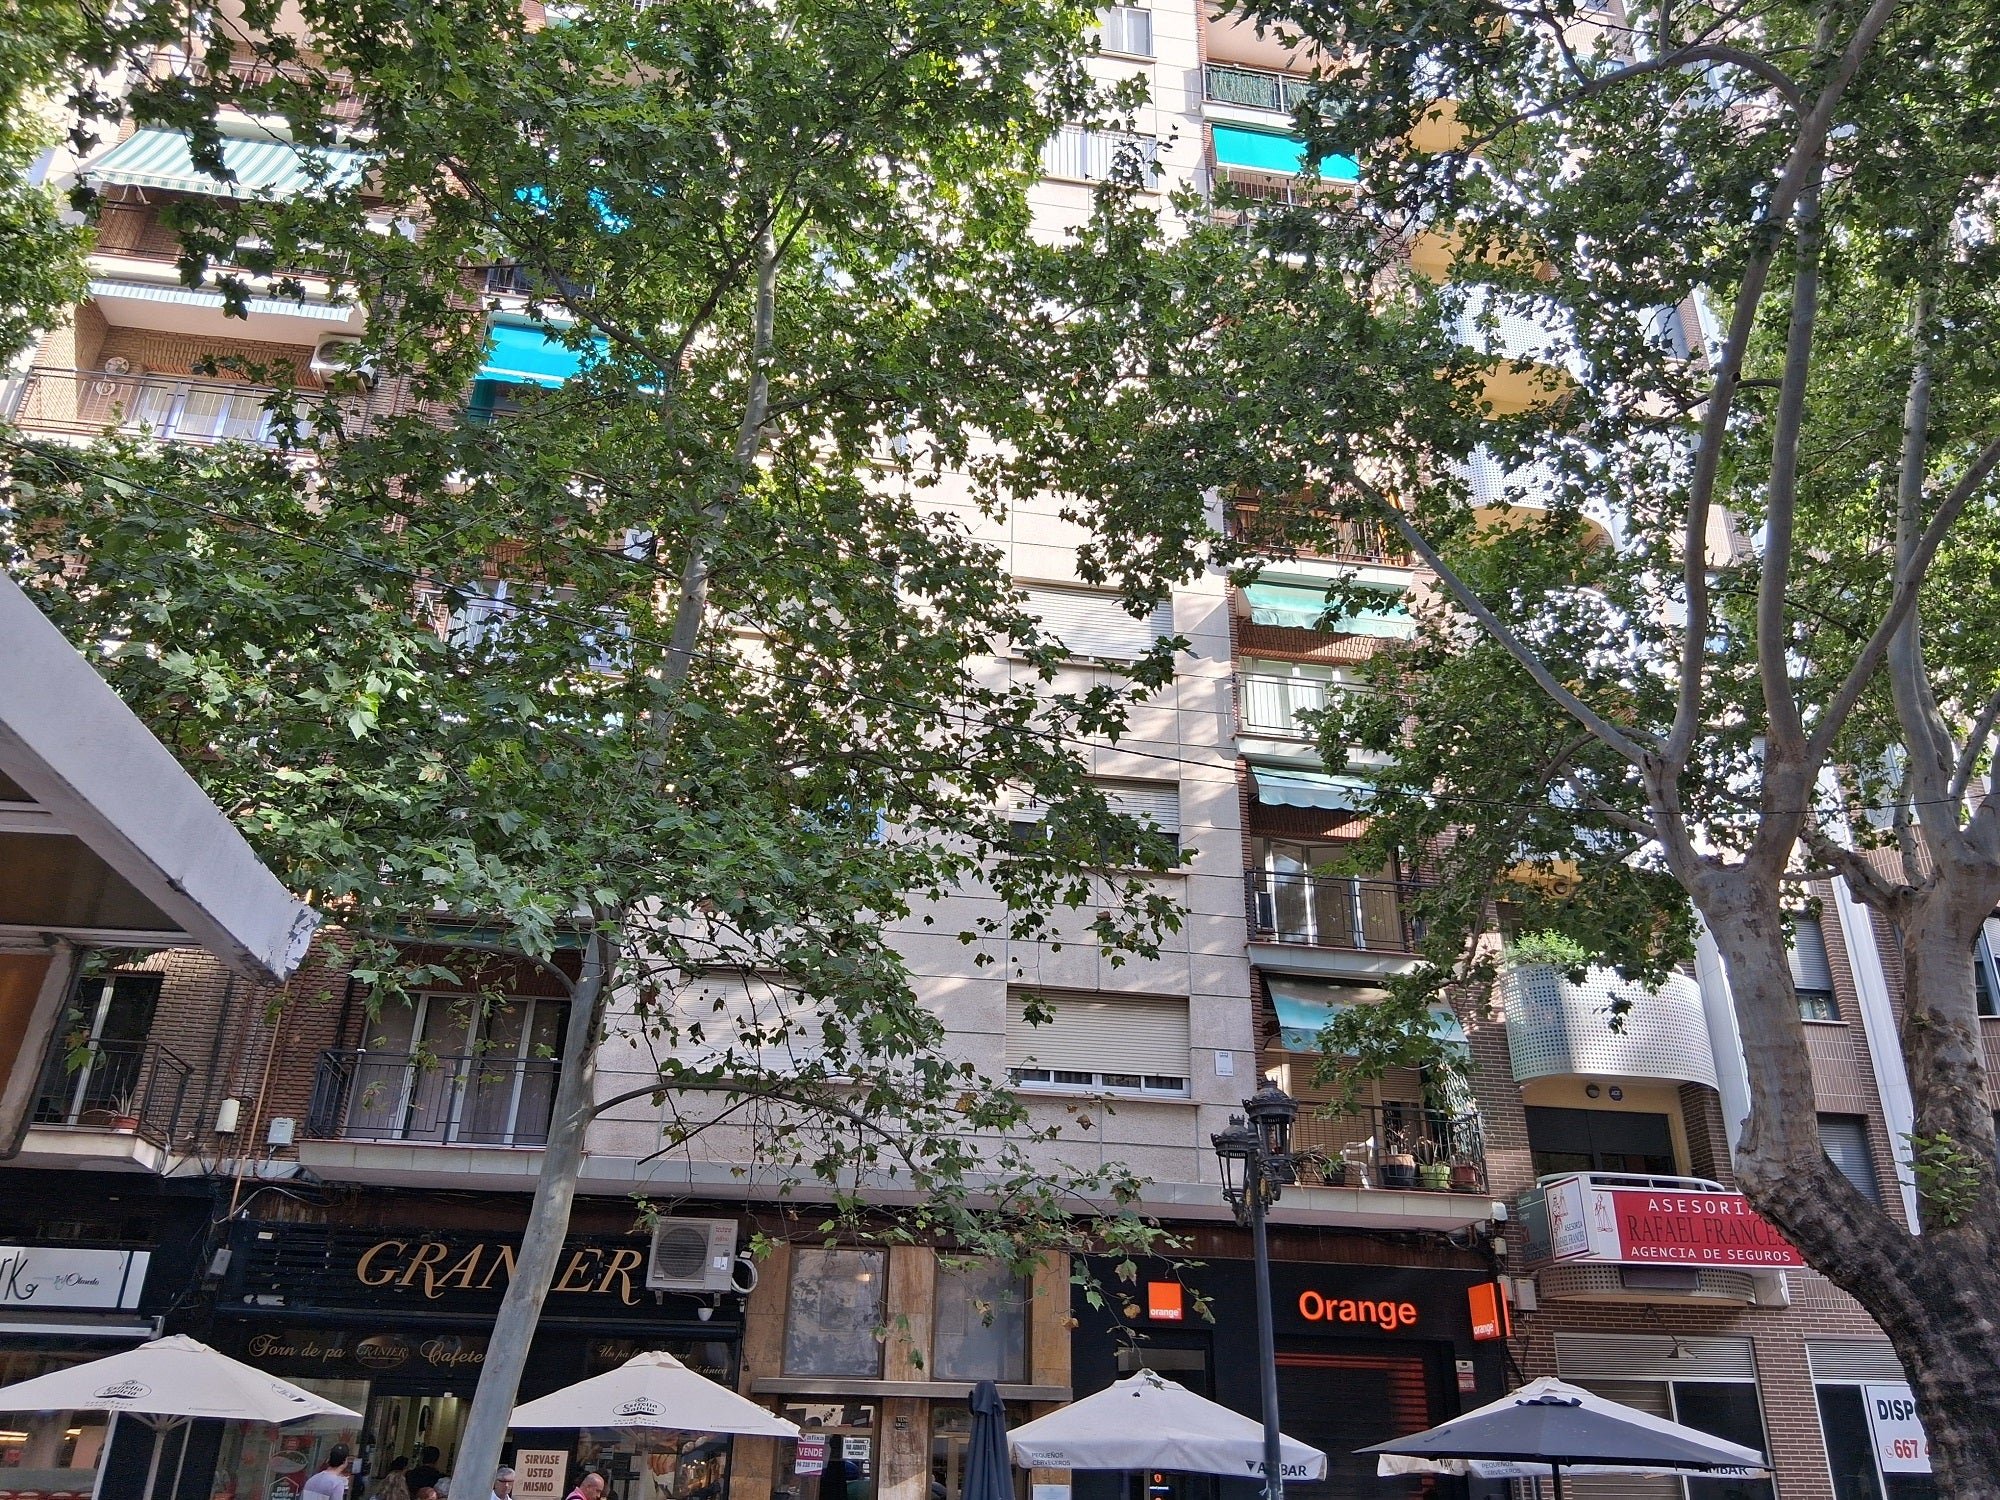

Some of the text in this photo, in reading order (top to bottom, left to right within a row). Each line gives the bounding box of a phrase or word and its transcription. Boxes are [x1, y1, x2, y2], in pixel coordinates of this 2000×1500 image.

[1628, 1215, 1702, 1243] RAFAEL
[1631, 1245, 1791, 1263] AGENCIA DE SEGUROS
[356, 1240, 643, 1306] GRANER
[1150, 1308, 1179, 1319] orange
[1299, 1290, 1417, 1329] Orange
[1474, 1322, 1494, 1335] orange
[301, 1342, 319, 1357] de
[356, 1345, 408, 1358] GRANIER
[420, 1340, 486, 1368] Cafete
[1876, 1399, 1914, 1421] DISP
[799, 1447, 823, 1457] VENDE
[1894, 1439, 1919, 1458] 667
[525, 1455, 560, 1465] SIRVASE
[527, 1468, 553, 1477] USTED
[1257, 1462, 1307, 1476] ABAR
[523, 1482, 554, 1492] MISMO
